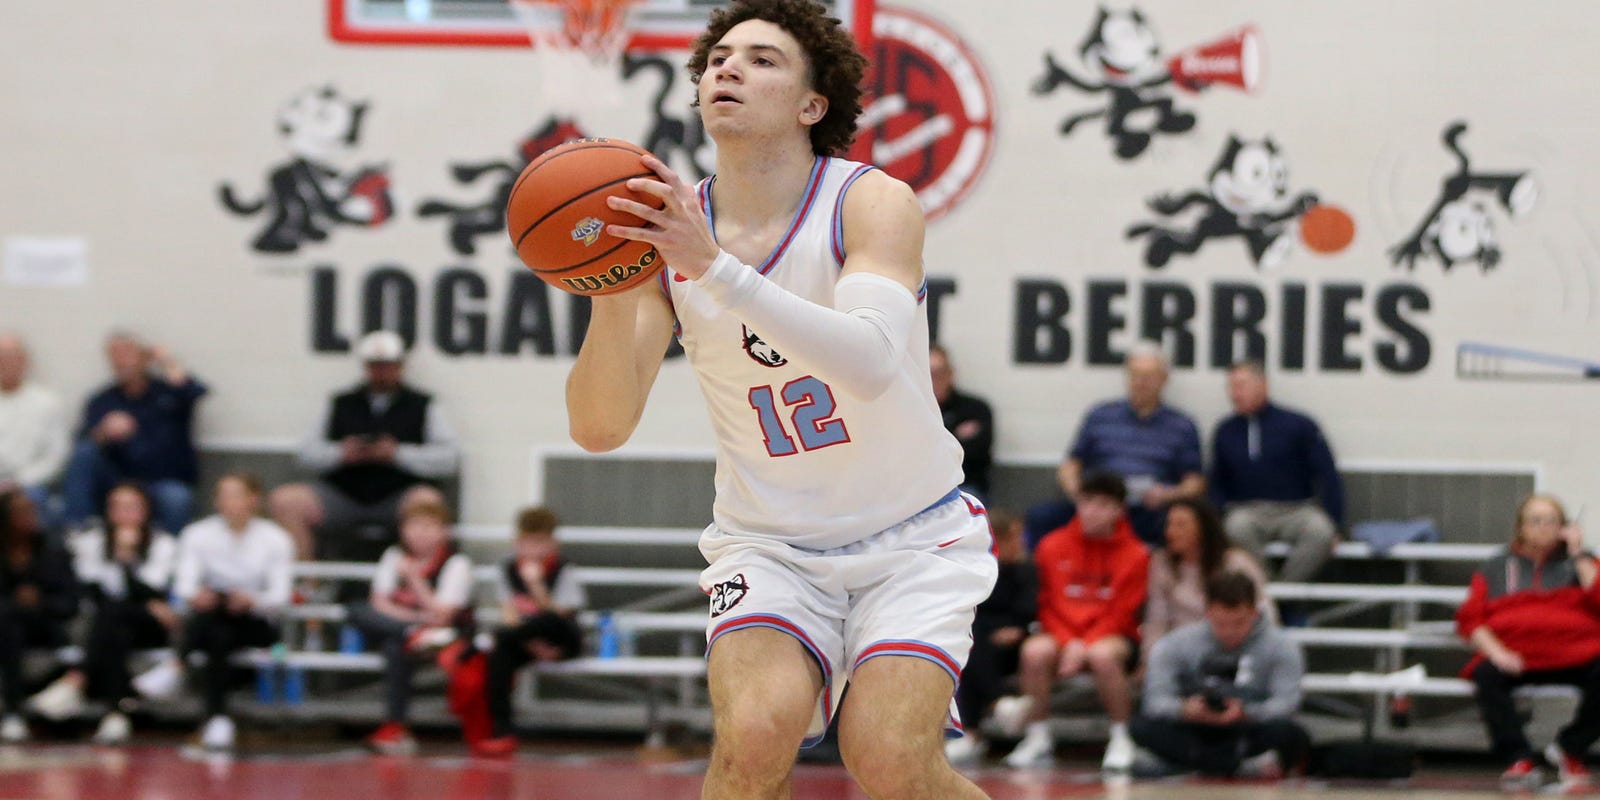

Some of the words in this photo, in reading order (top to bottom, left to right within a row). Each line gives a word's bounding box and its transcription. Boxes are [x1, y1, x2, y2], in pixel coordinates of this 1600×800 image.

[561, 250, 656, 292] Wilso
[1013, 278, 1432, 374] BERRIES
[748, 375, 851, 457] 12
